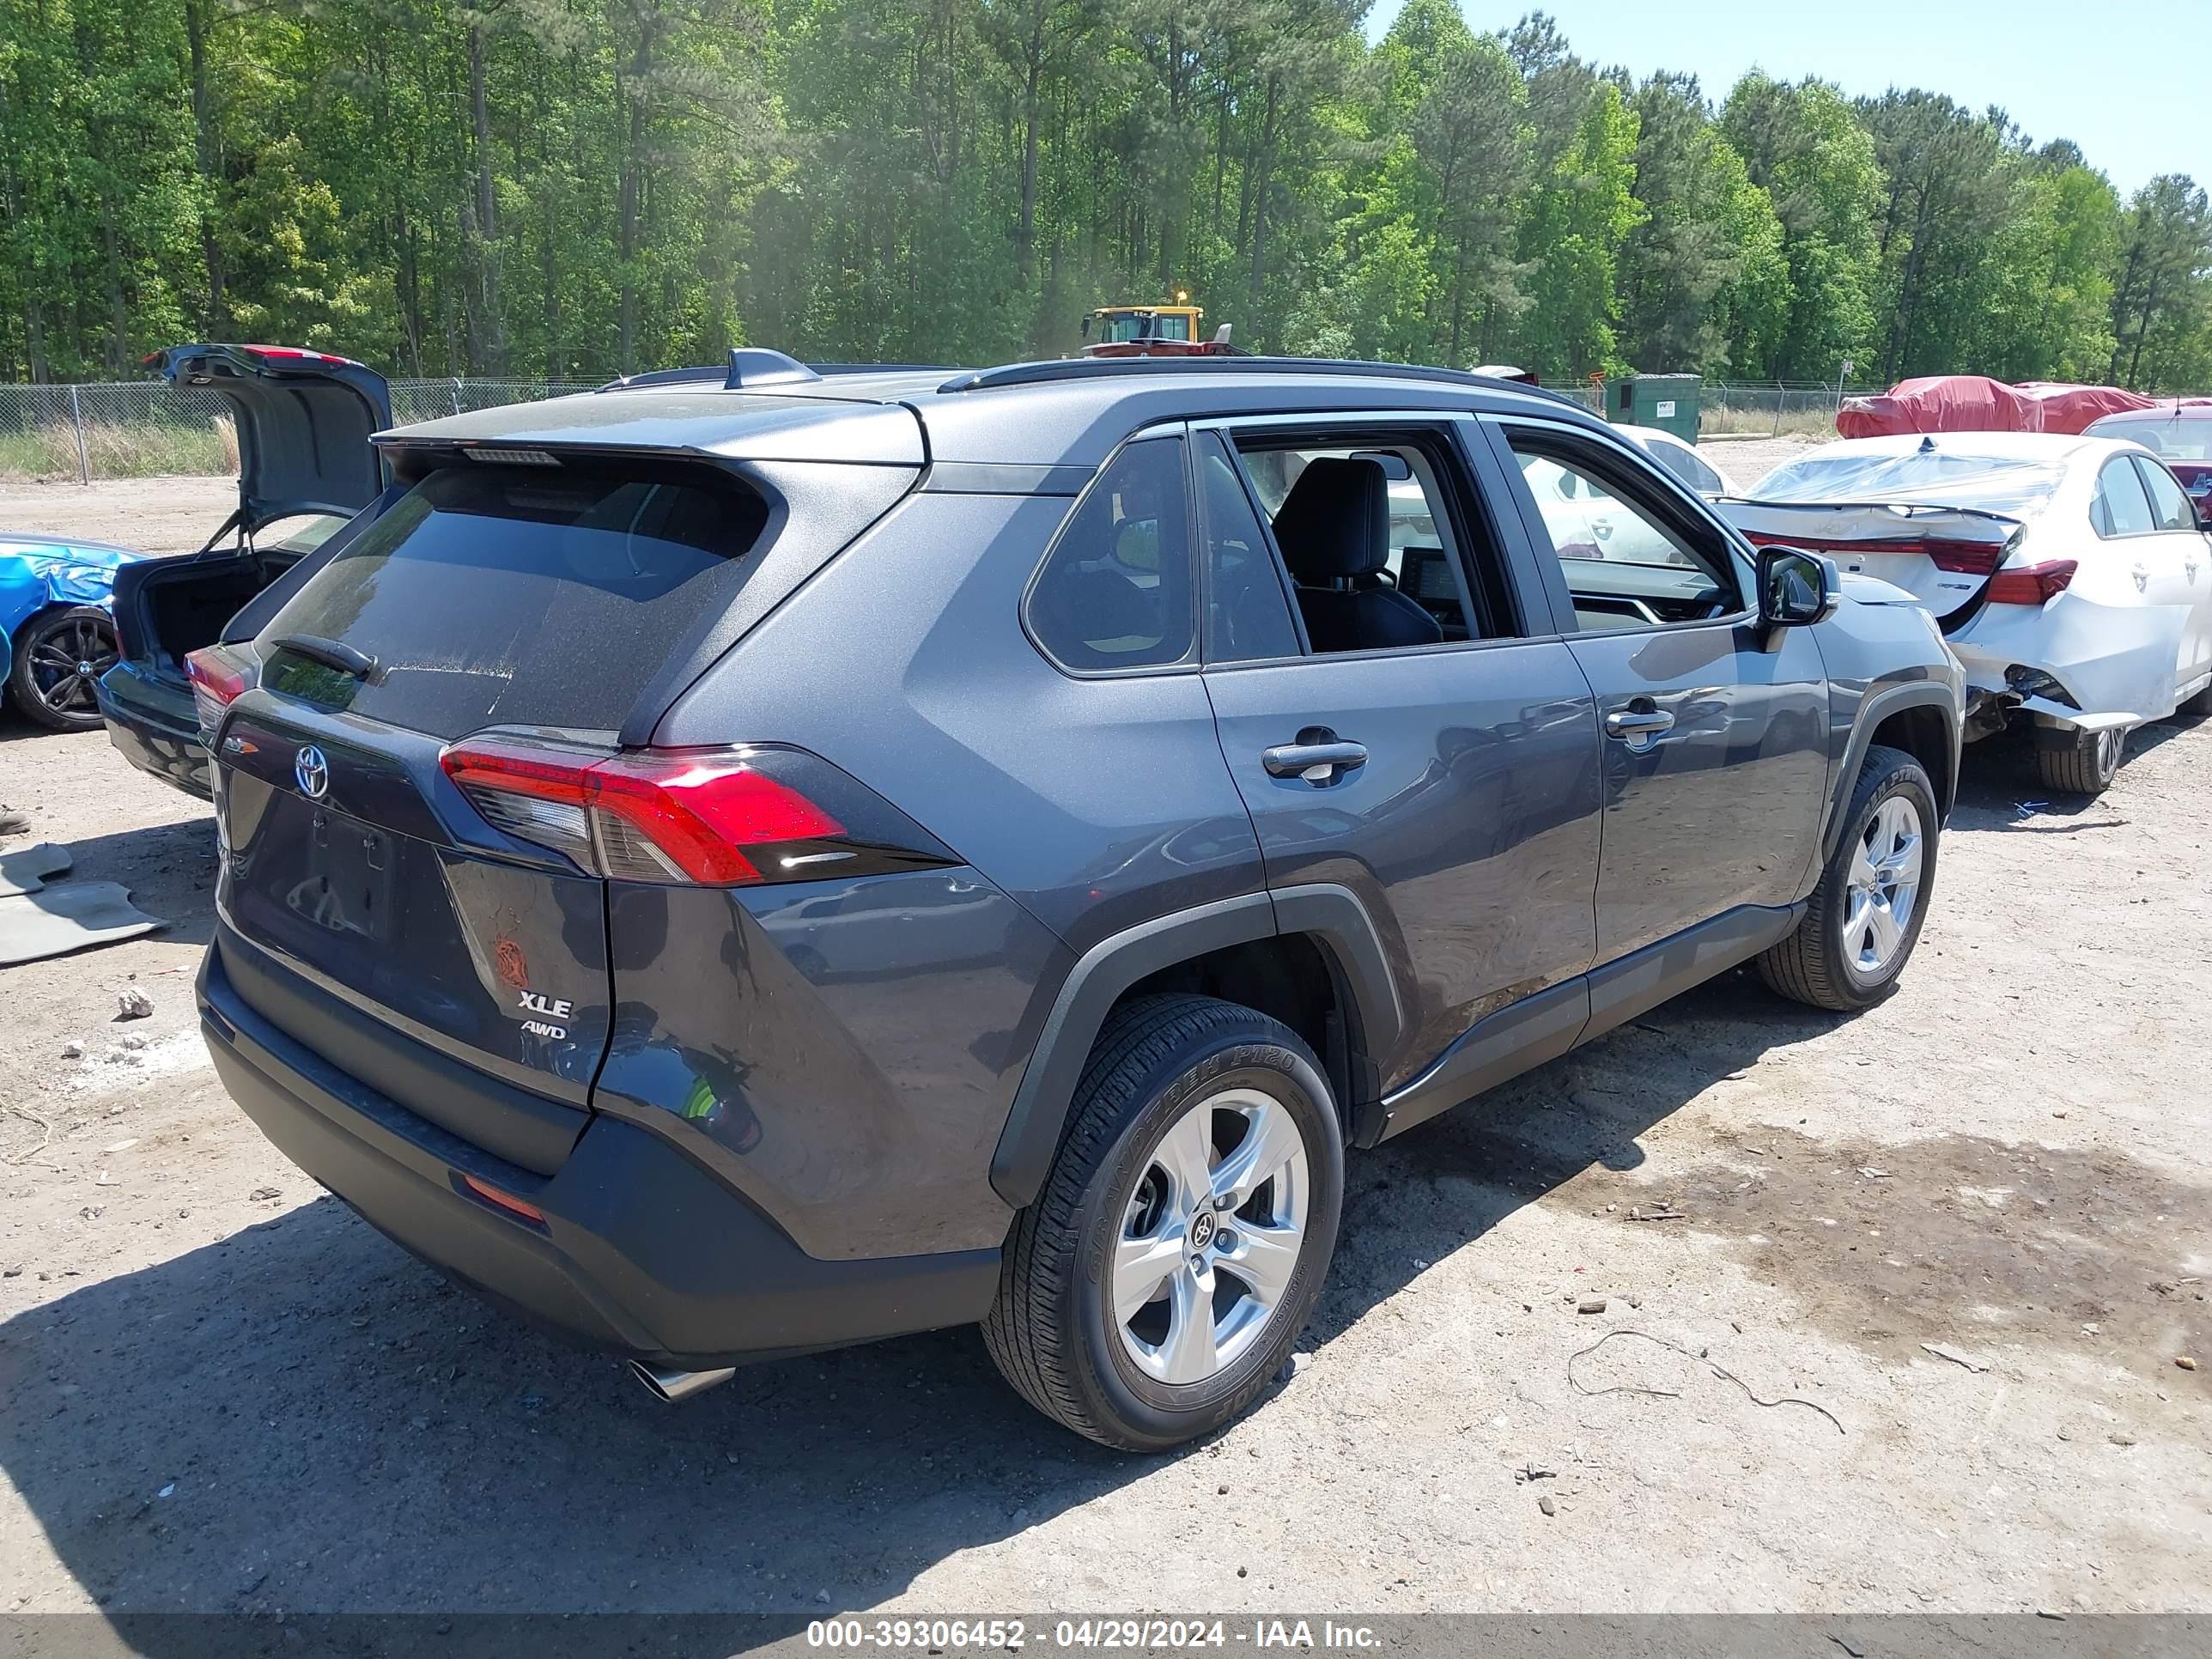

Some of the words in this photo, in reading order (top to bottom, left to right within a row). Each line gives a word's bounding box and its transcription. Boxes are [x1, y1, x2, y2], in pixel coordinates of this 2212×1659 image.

[518, 990, 573, 1019] XLE
[520, 1020, 567, 1041] AWD
[1231, 1043, 1297, 1073] PT20
